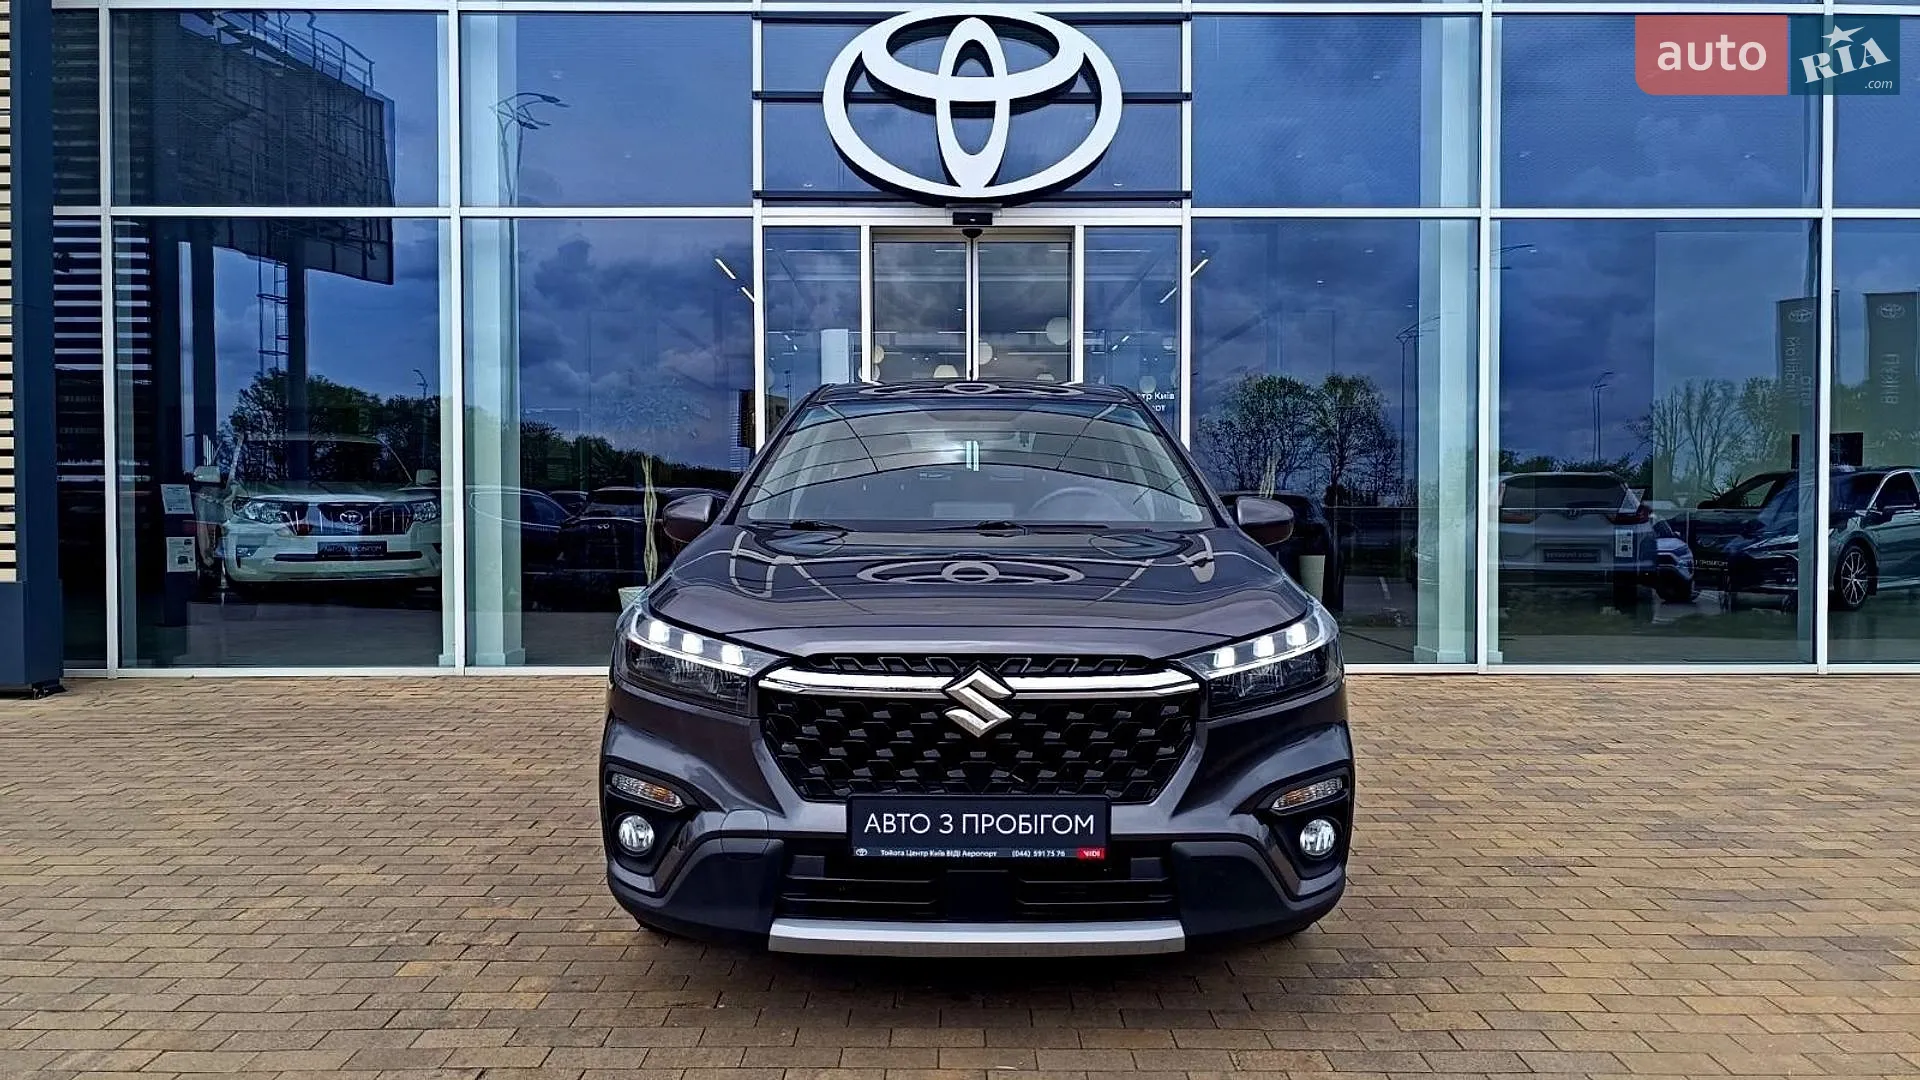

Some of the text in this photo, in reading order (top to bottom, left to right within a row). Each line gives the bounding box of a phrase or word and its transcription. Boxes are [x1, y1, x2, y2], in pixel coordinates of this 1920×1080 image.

[864, 813, 931, 834] АВТО
[962, 814, 1095, 834] ПРОБІГОМ
[905, 849, 929, 858] Центр
[929, 849, 946, 857] Київ
[962, 849, 997, 858] Аеропорт
[1012, 849, 1031, 858] (044)
